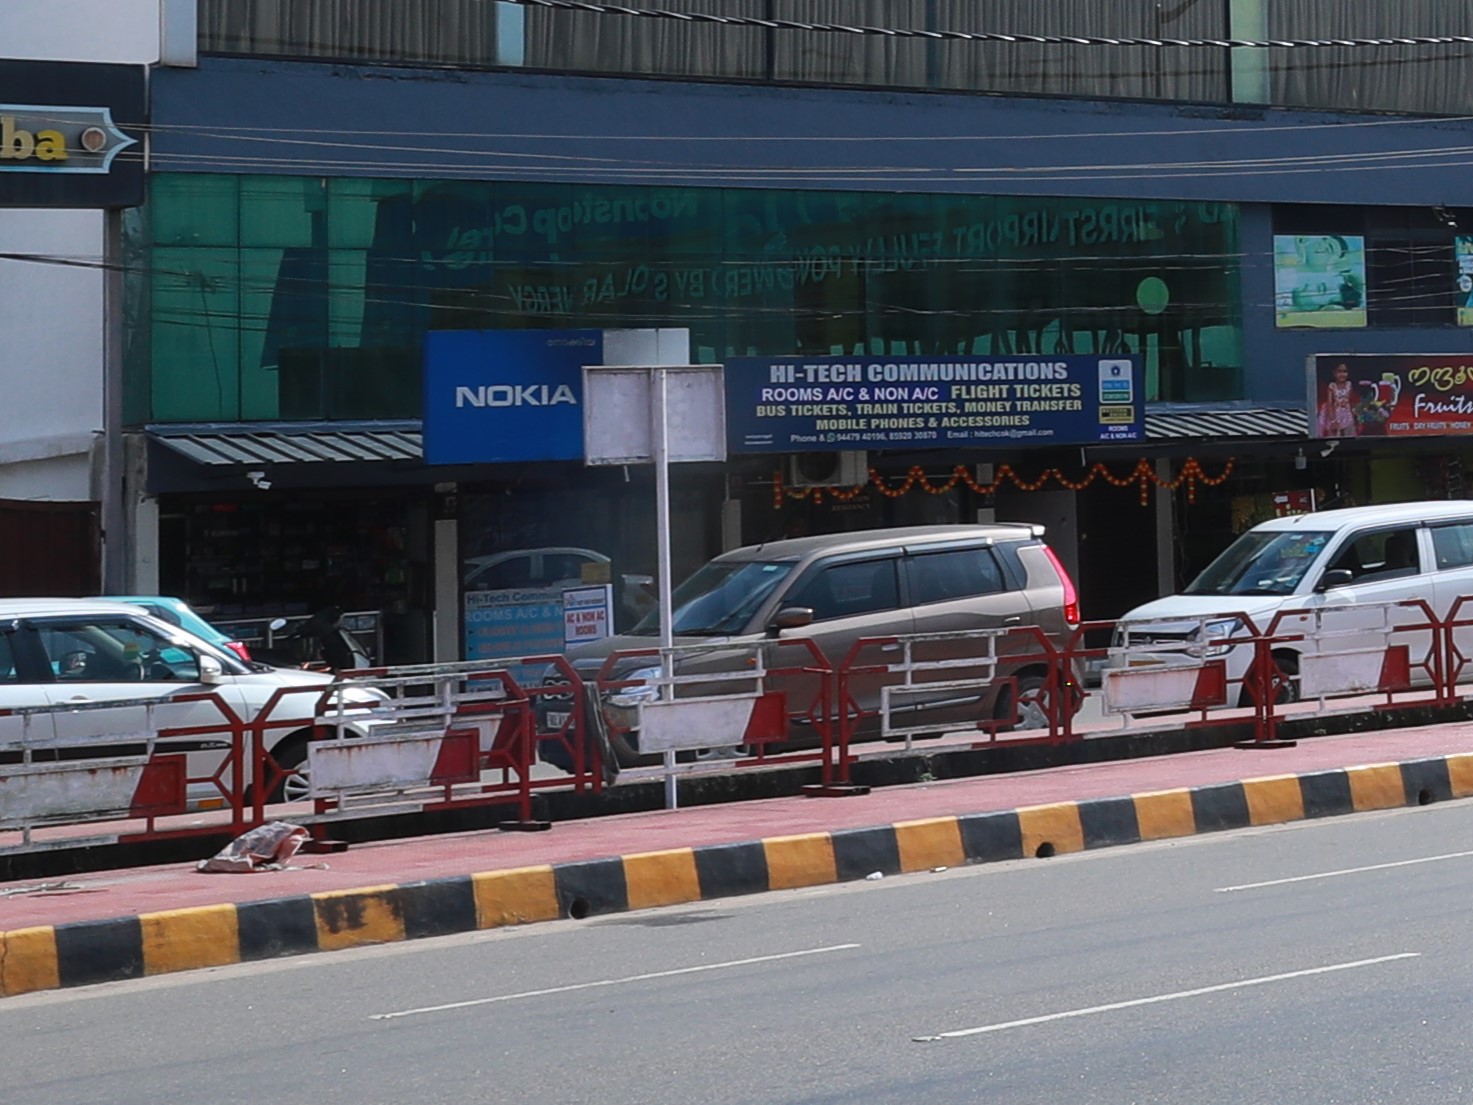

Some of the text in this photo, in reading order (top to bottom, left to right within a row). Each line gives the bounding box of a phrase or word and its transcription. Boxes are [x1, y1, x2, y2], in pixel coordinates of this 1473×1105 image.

[770, 361, 1068, 384] HI-TECH COMMUNICATIONS
[455, 383, 577, 408] NOKIA
[762, 386, 938, 402] ROOMS A/C & NON A/C
[951, 384, 1011, 400] FLIGHT
[1014, 382, 1081, 398] TICKETS
[756, 400, 1082, 417] BUS TICKETS, TRAIN TICKETS, MONEY TRANSFER
[816, 415, 1030, 431] MOBILE PHONES & ACCESSORIES
[790, 433, 817, 443] Phone
[947, 429, 968, 438] Email
[467, 592, 510, 604] Hi-Tech
[466, 610, 513, 622] ROOMS
